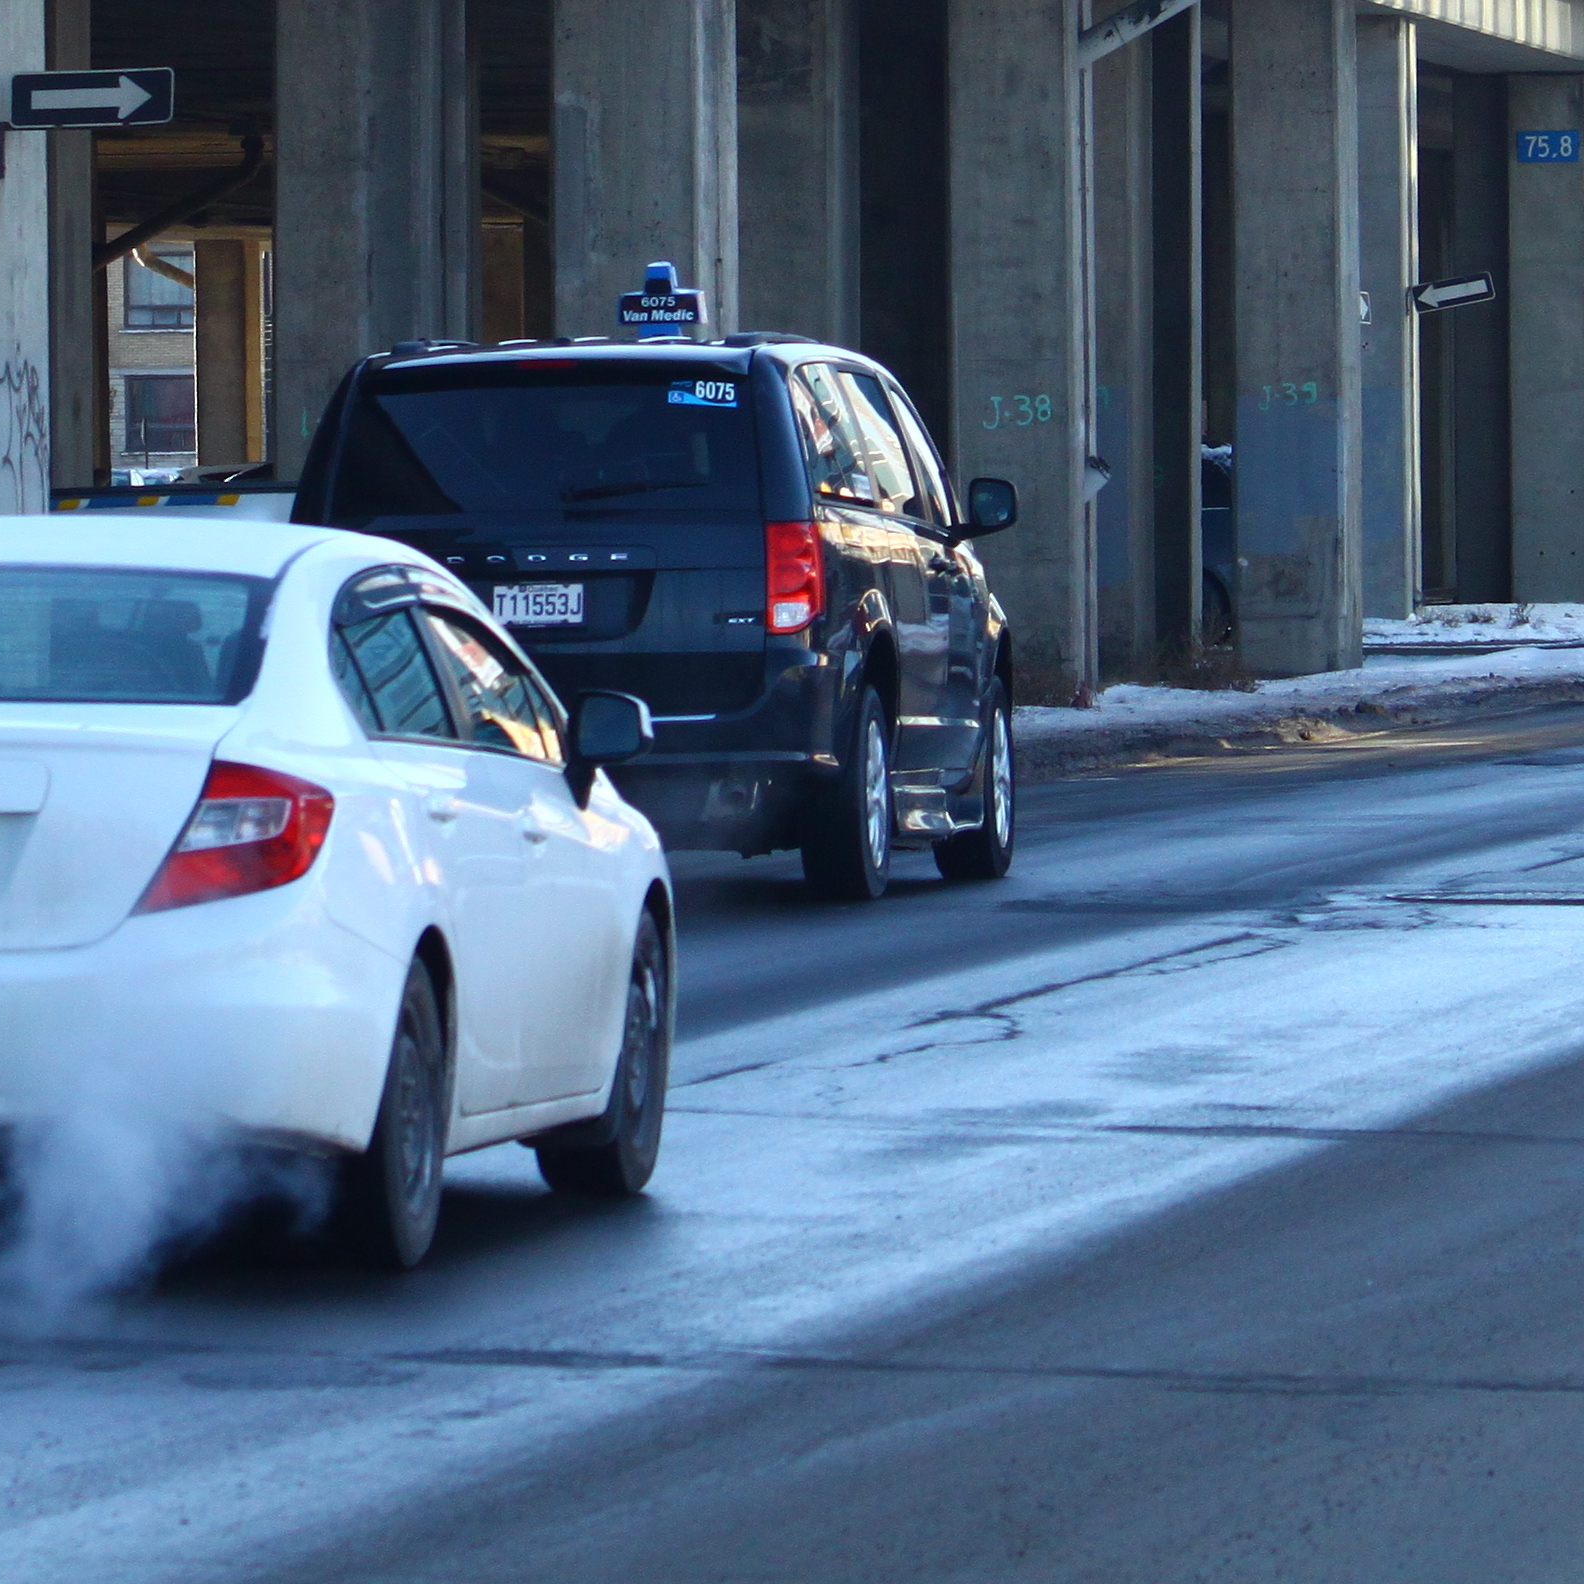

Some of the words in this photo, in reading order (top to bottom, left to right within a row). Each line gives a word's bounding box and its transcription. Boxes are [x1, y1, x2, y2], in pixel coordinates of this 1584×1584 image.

[641, 296, 676, 307] 6075
[622, 309, 649, 322] Van
[651, 308, 695, 321] Medic
[695, 380, 735, 401] 6075
[496, 592, 582, 616] T11553J
